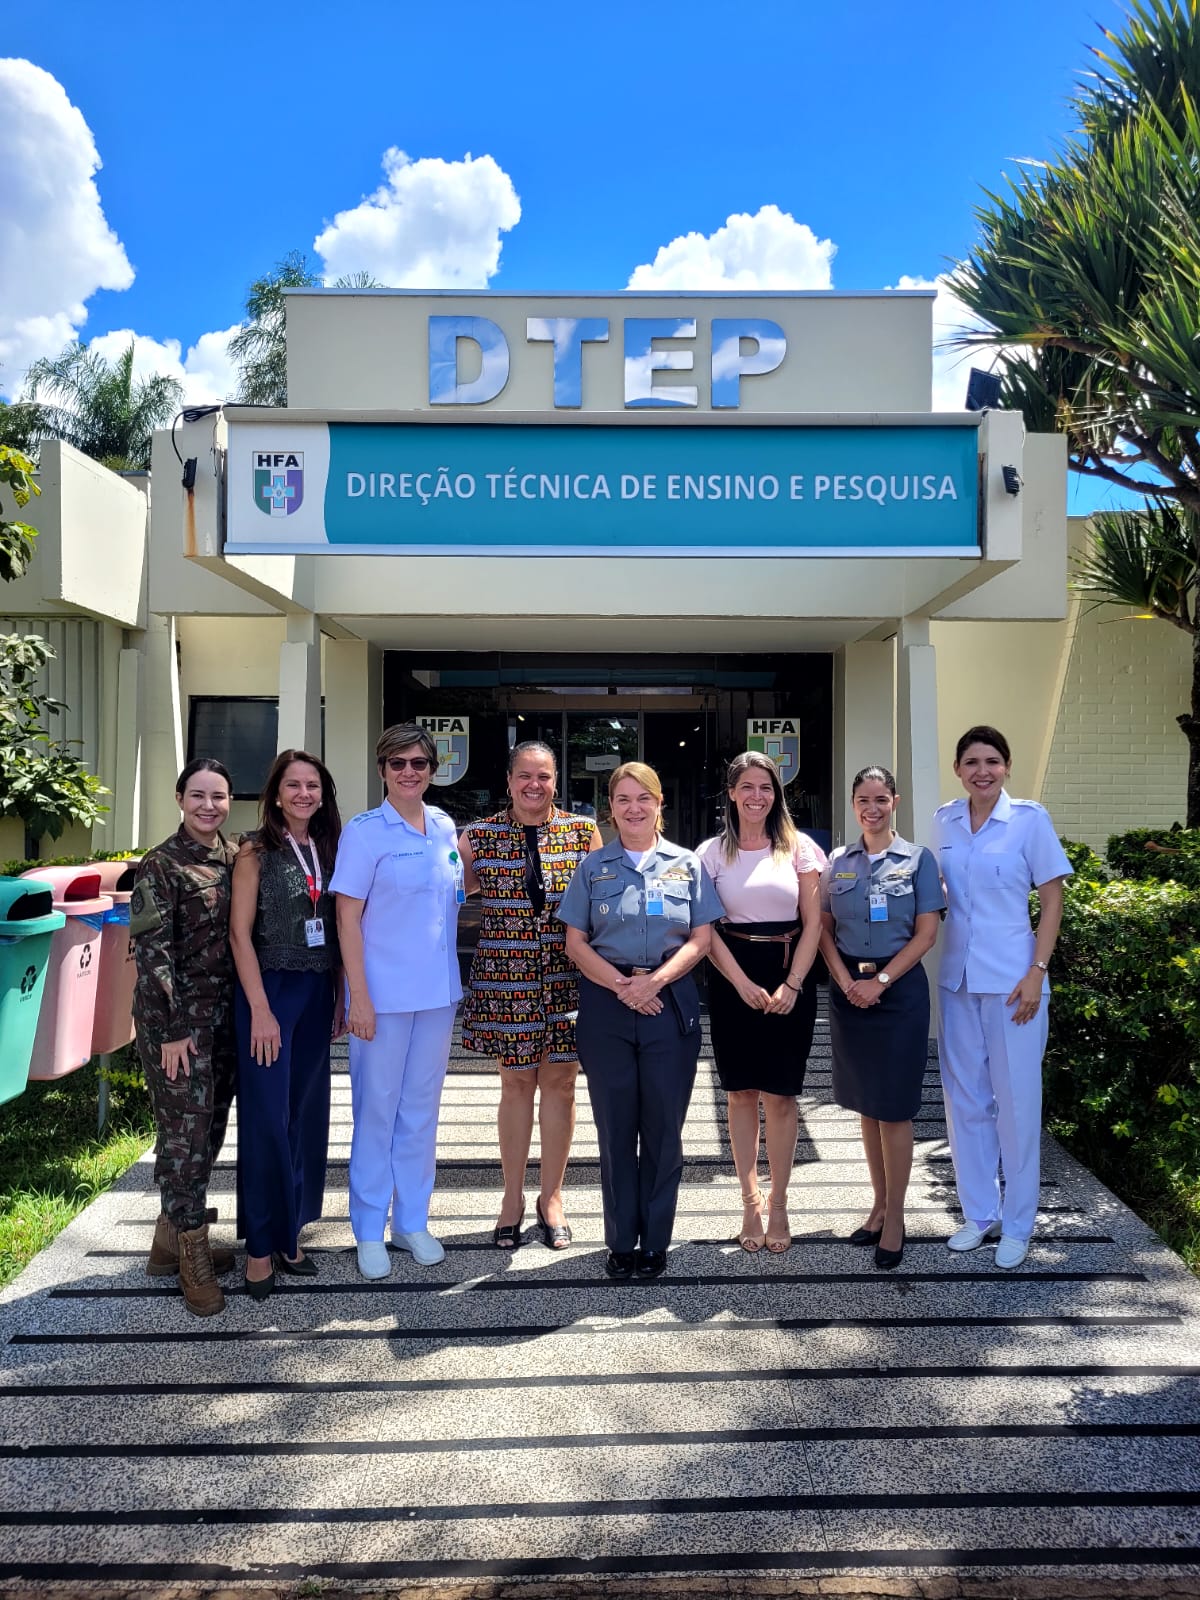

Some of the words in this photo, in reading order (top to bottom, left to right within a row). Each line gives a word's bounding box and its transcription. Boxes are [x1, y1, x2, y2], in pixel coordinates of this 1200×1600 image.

[429, 315, 787, 409] DTEP
[257, 454, 299, 468] HFA
[347, 467, 476, 506] DIREÇÃO
[485, 465, 611, 500] TÉCNICA
[621, 474, 657, 500] DE
[667, 474, 779, 500] ENSINO
[790, 475, 804, 500] E
[814, 475, 958, 506] PESQUISA
[421, 718, 465, 733] HFA
[752, 720, 796, 734] HFA
